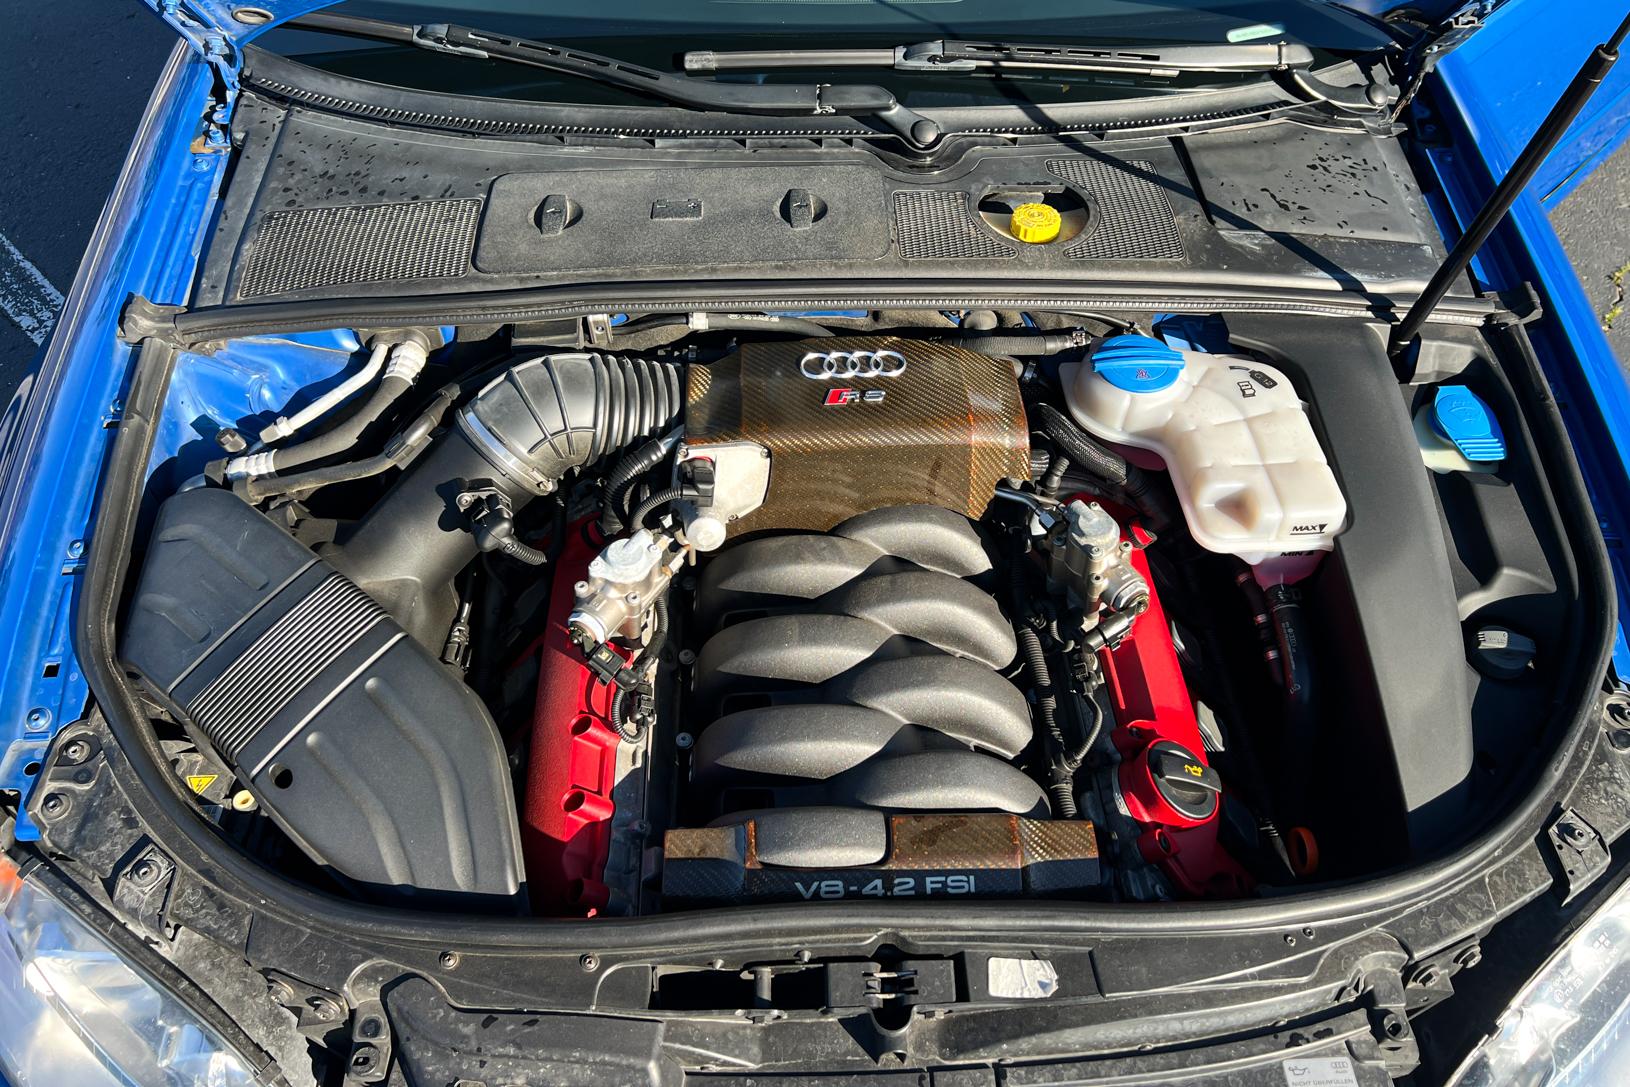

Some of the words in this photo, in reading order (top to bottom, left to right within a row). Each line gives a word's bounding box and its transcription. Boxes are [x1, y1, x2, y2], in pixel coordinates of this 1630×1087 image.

[827, 388, 886, 405] RS
[1292, 524, 1318, 532] MAX
[925, 875, 976, 895] FSI
